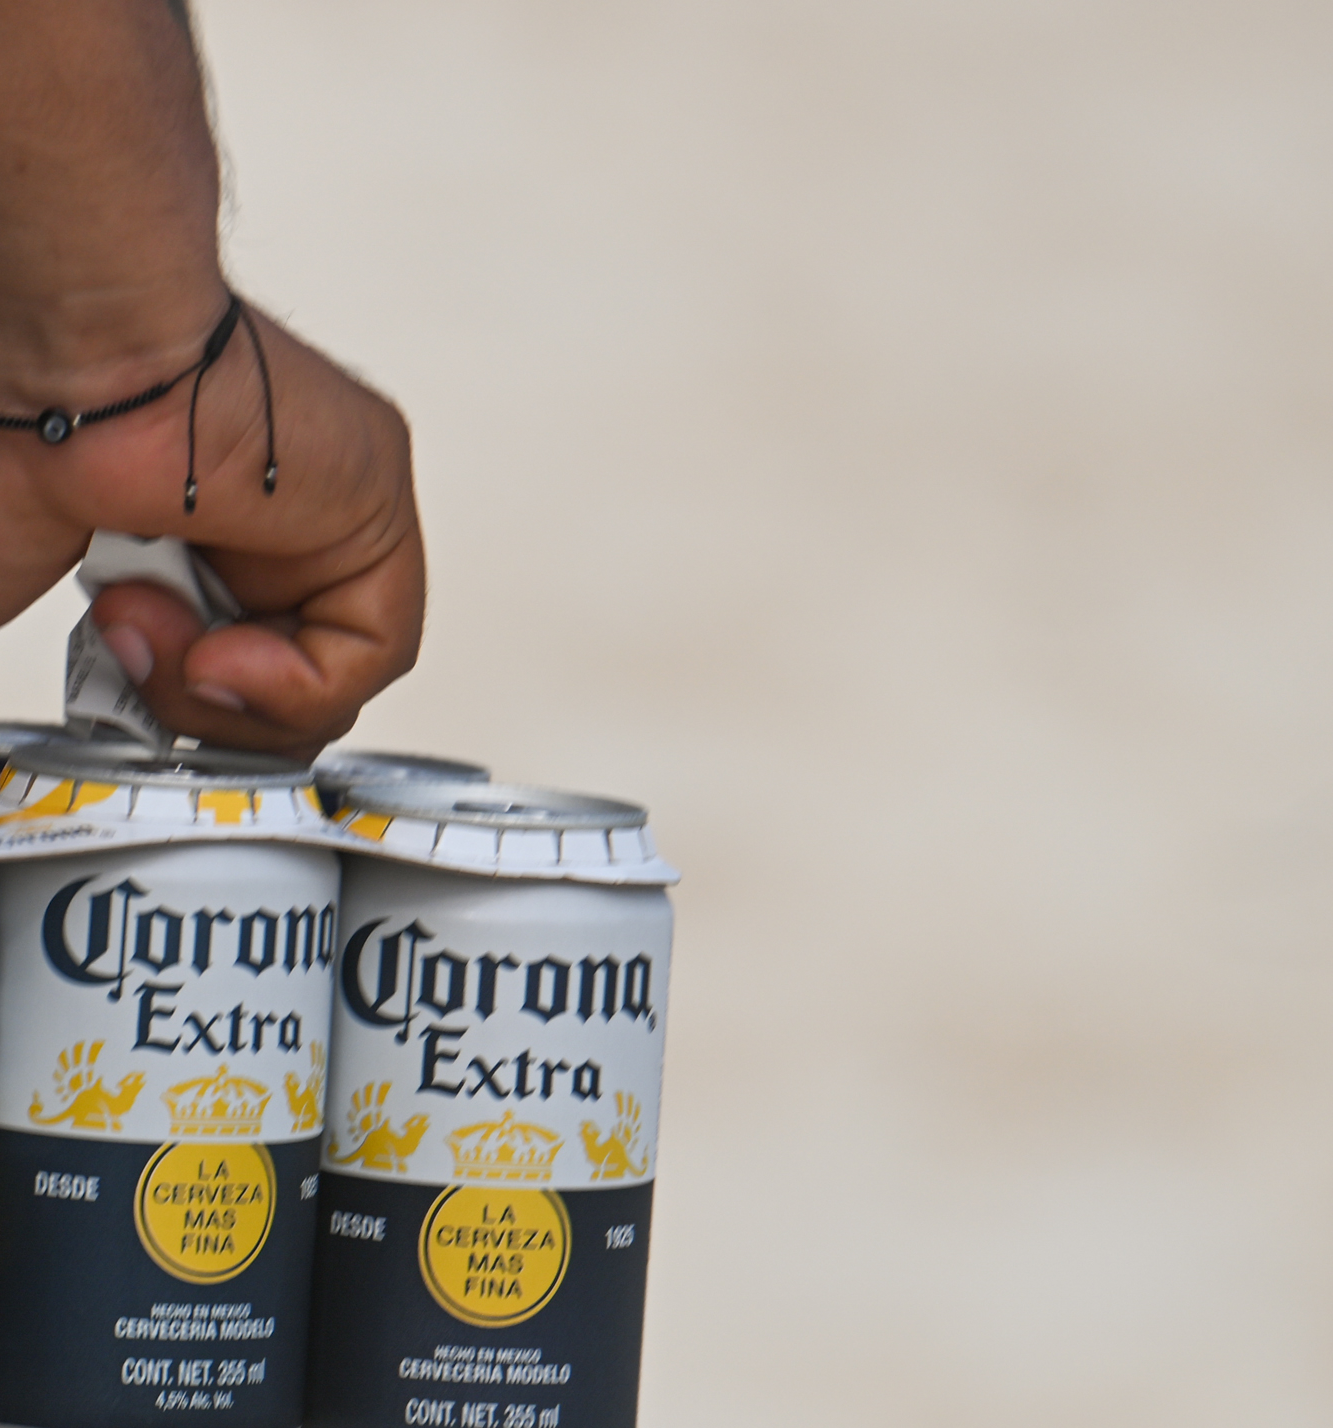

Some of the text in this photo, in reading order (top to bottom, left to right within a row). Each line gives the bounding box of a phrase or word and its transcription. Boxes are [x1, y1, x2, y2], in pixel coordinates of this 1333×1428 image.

[41, 874, 335, 1001] Corona
[342, 916, 652, 1044] Corona
[132, 980, 303, 1055] Extra
[416, 1024, 603, 1101] Extra
[198, 1159, 230, 1181] LA
[34, 1170, 100, 1202] DESDE
[153, 1182, 264, 1206] CERVEZA
[184, 1208, 237, 1231] MAS
[331, 1210, 387, 1242] DESDE
[482, 1204, 517, 1226] LA
[181, 1233, 235, 1256] FINA
[436, 1226, 556, 1252] CERVEZA
[605, 1224, 635, 1250] 1925
[467, 1253, 525, 1276] MAS
[464, 1276, 524, 1300] FINA
[150, 1302, 252, 1321] HECHO EN MEXICO
[114, 1316, 276, 1341] CERVECERIA MODELO
[434, 1345, 542, 1365] HECHO EN MEXICO
[121, 1357, 266, 1386] CONT. NET. 355 ml
[399, 1357, 572, 1386] CERVECERIA MODELO
[405, 1398, 457, 1428] CONT.
